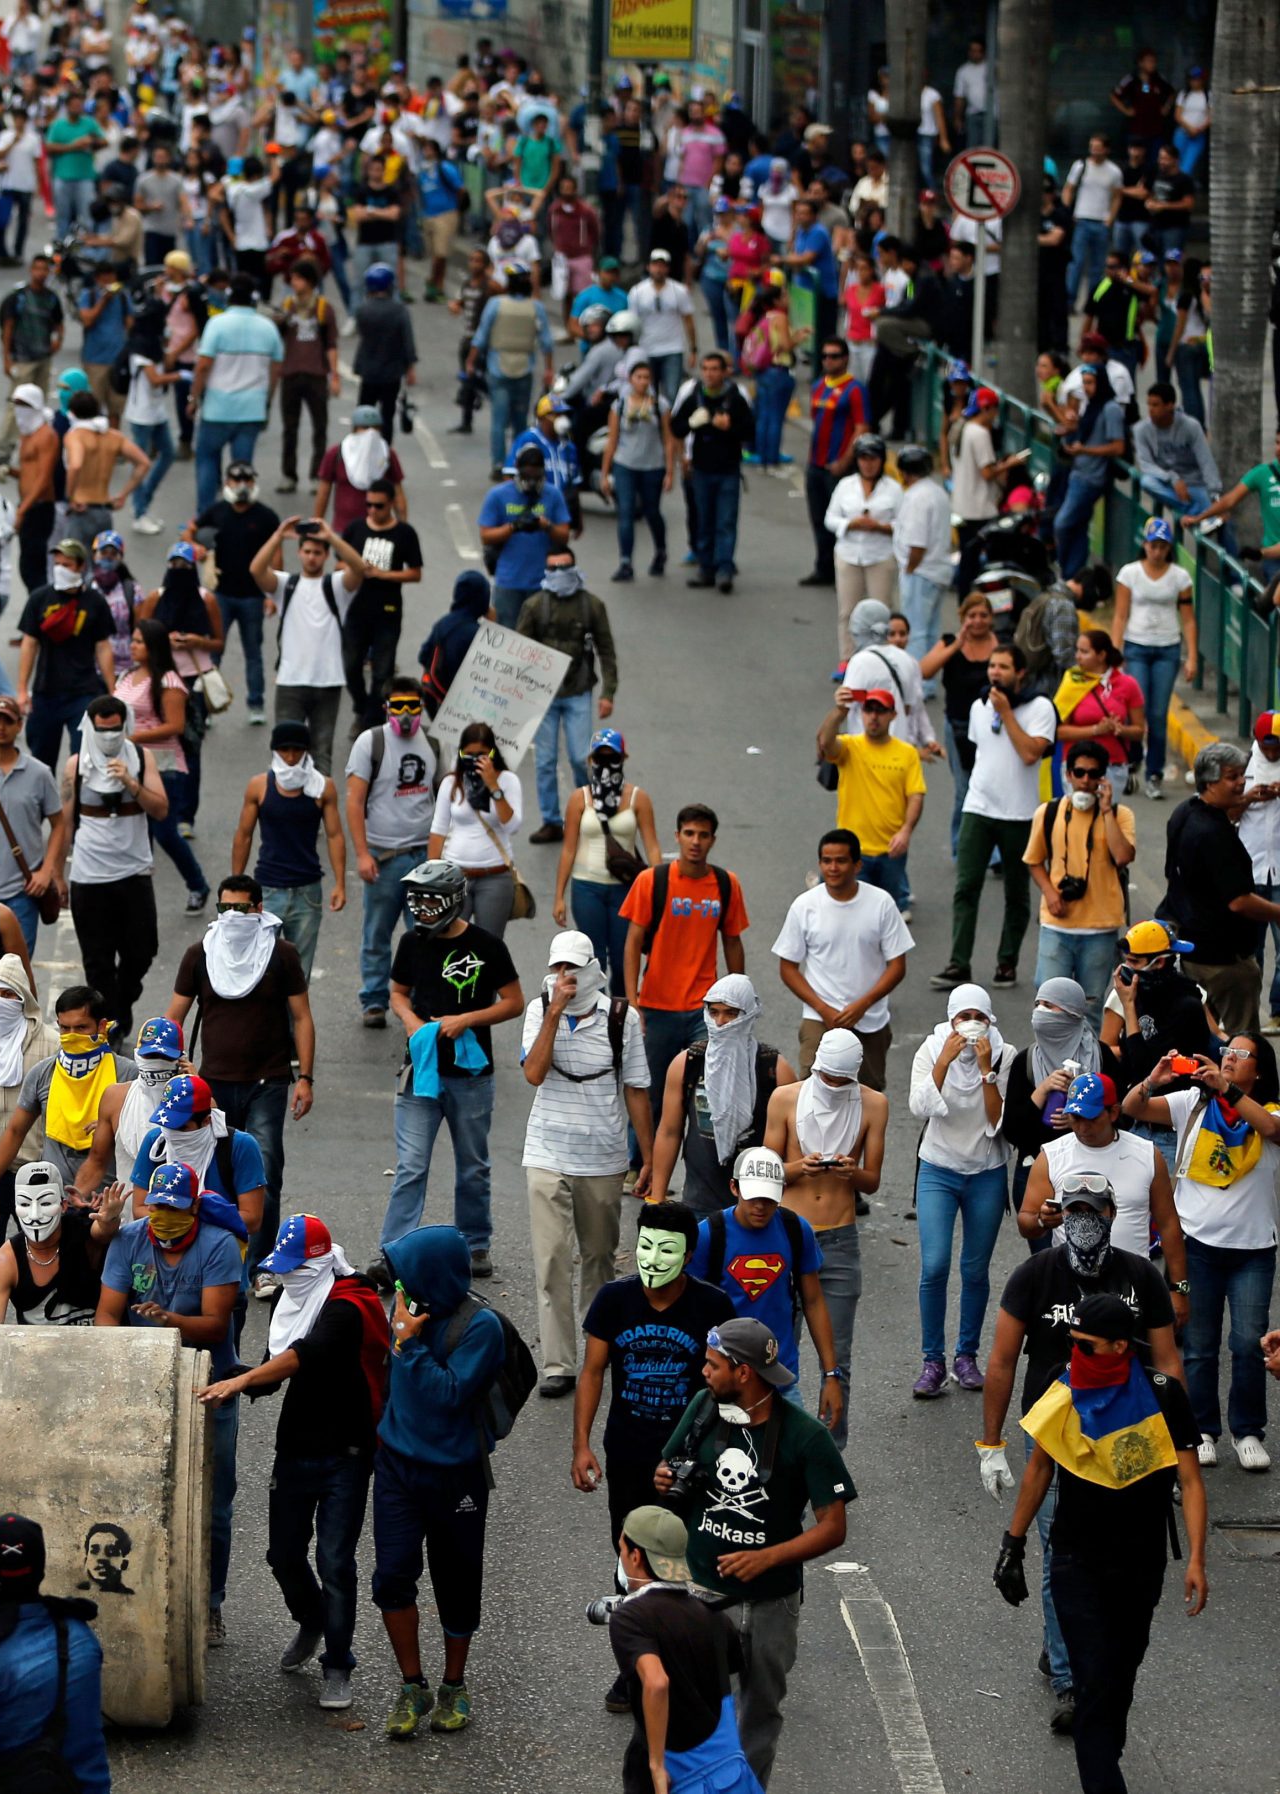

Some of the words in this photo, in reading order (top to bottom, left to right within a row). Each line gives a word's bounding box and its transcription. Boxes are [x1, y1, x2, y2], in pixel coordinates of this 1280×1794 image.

[480, 628, 504, 649] NO
[473, 651, 491, 670] POR
[493, 661, 514, 677] ESTA
[472, 686, 508, 709] MEJOR
[629, 1340, 684, 1354] COMPANY
[621, 1389, 640, 1402] AND
[642, 1395, 660, 1407] THE
[663, 1396, 687, 1406] WAVE
[698, 1511, 766, 1544] jackass
